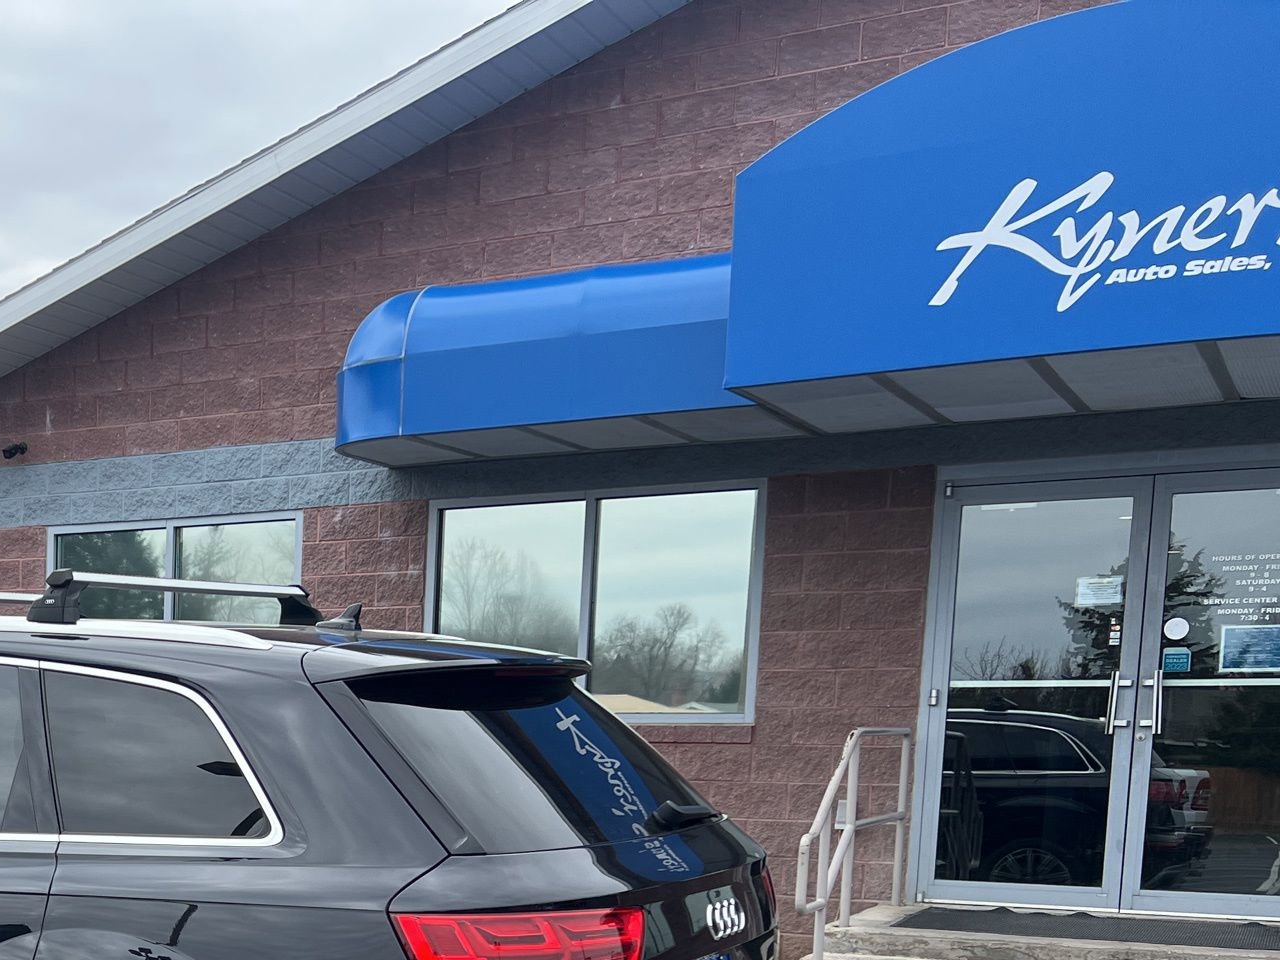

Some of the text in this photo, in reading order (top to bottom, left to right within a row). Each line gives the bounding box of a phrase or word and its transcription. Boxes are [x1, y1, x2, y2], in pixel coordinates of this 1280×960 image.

[928, 171, 1280, 312] Kyner
[1104, 254, 1272, 285] Auto Sales,
